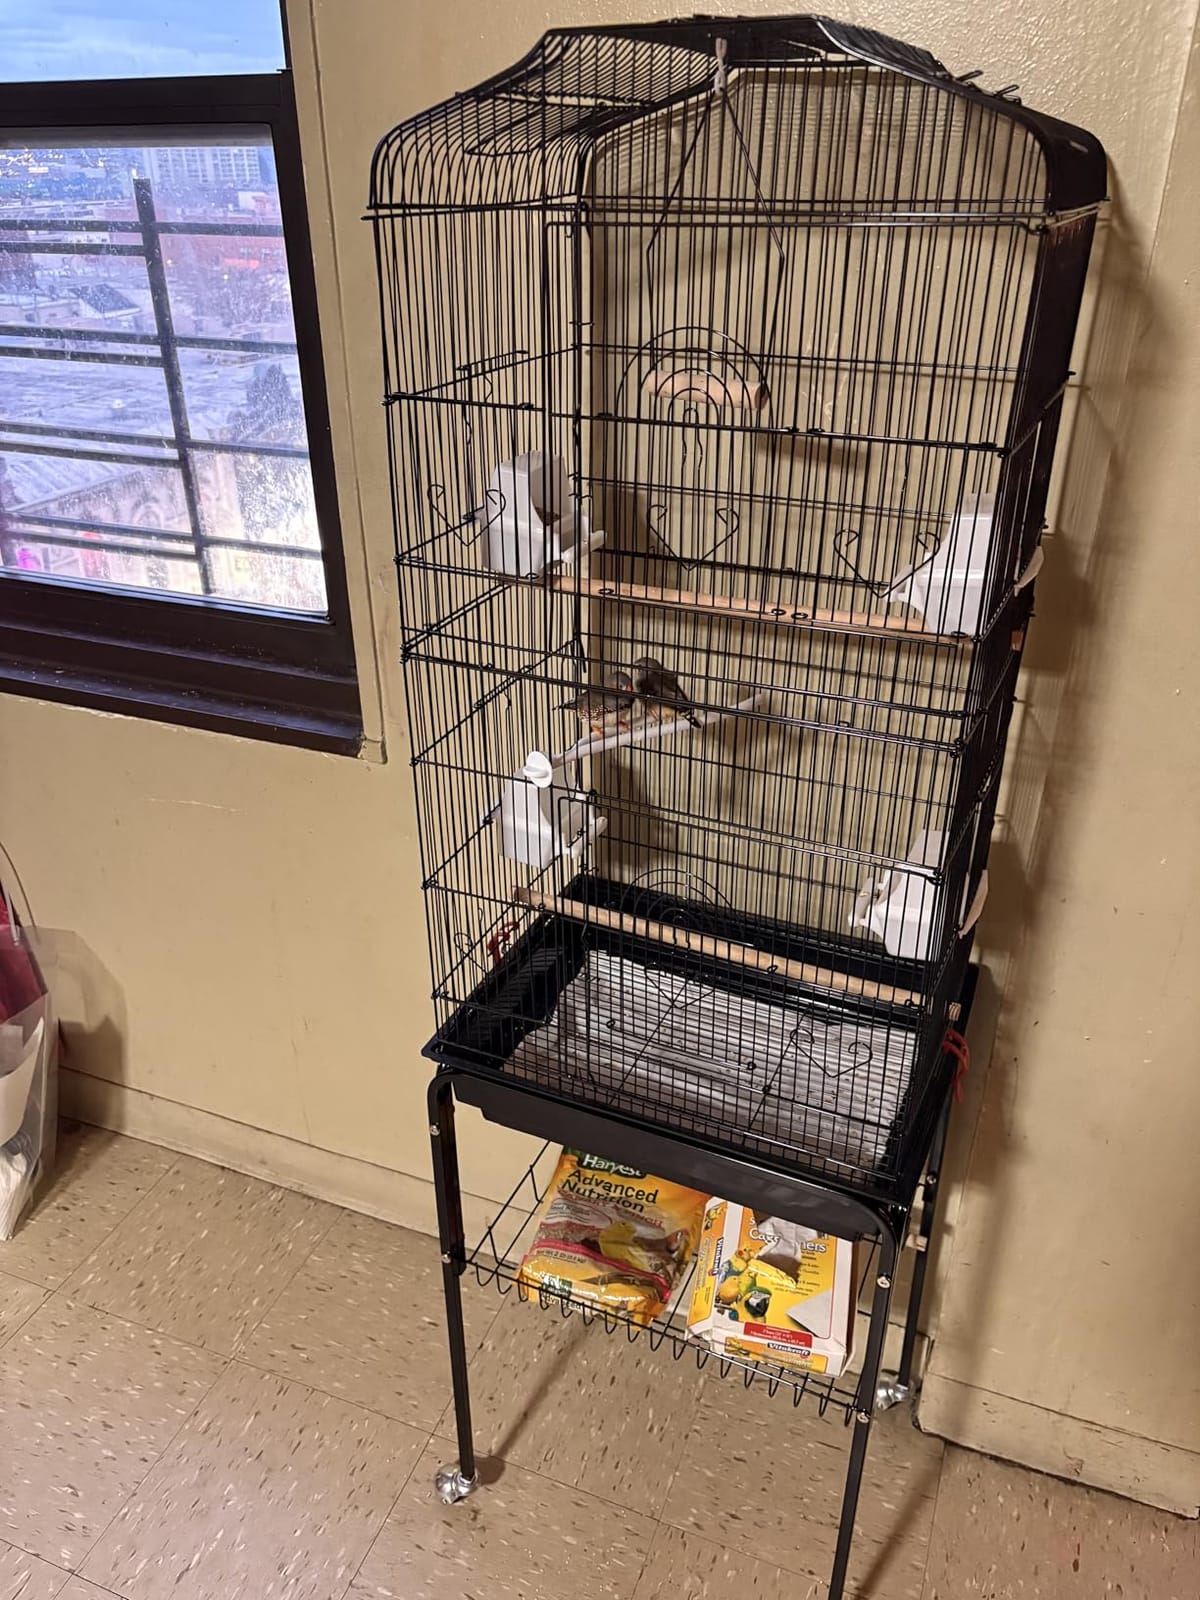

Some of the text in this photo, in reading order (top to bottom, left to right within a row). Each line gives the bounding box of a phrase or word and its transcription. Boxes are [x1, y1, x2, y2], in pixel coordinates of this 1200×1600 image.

[561, 1178, 645, 1213] Nutrition
[568, 1169, 659, 1204] Advanced
[767, 1342, 810, 1356] Vitakraft
